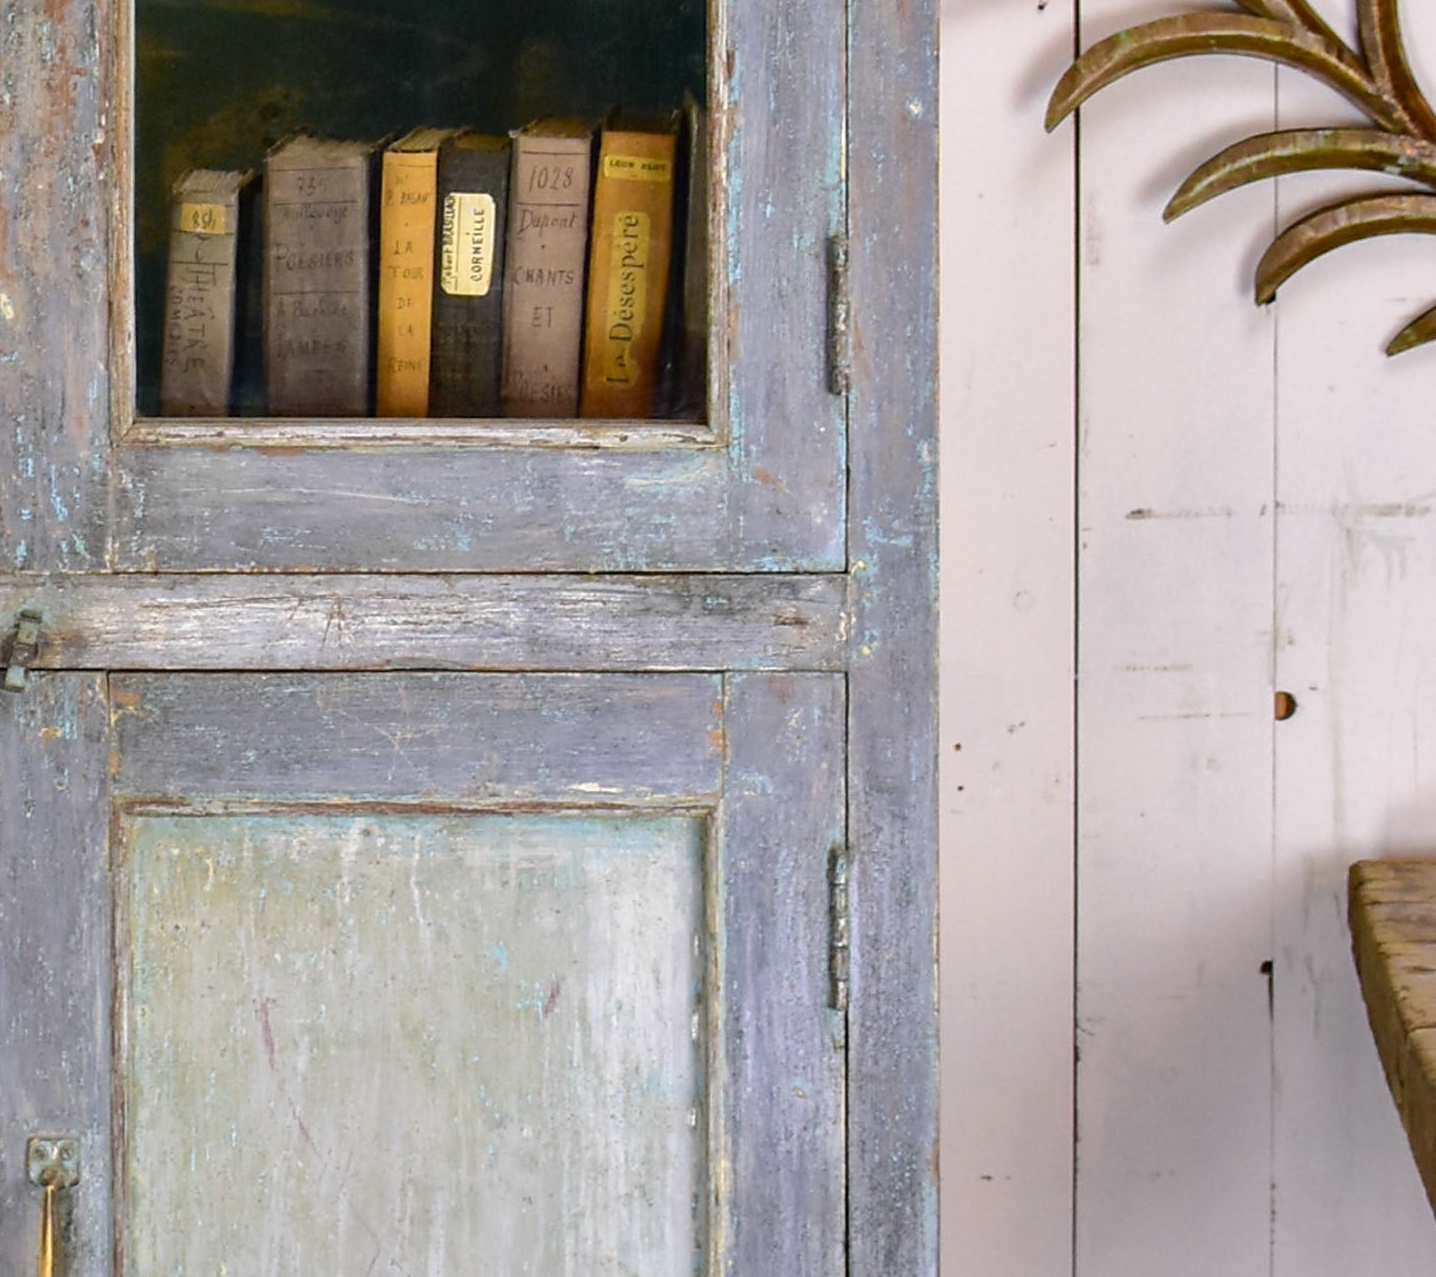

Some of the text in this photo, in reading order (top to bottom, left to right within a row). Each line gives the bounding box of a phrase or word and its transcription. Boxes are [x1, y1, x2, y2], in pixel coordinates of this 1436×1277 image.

[528, 164, 574, 193] 1028
[516, 208, 577, 237] Dupont
[513, 265, 574, 286] CHANTS
[609, 214, 644, 342] Désespéré
[531, 306, 555, 329] ET
